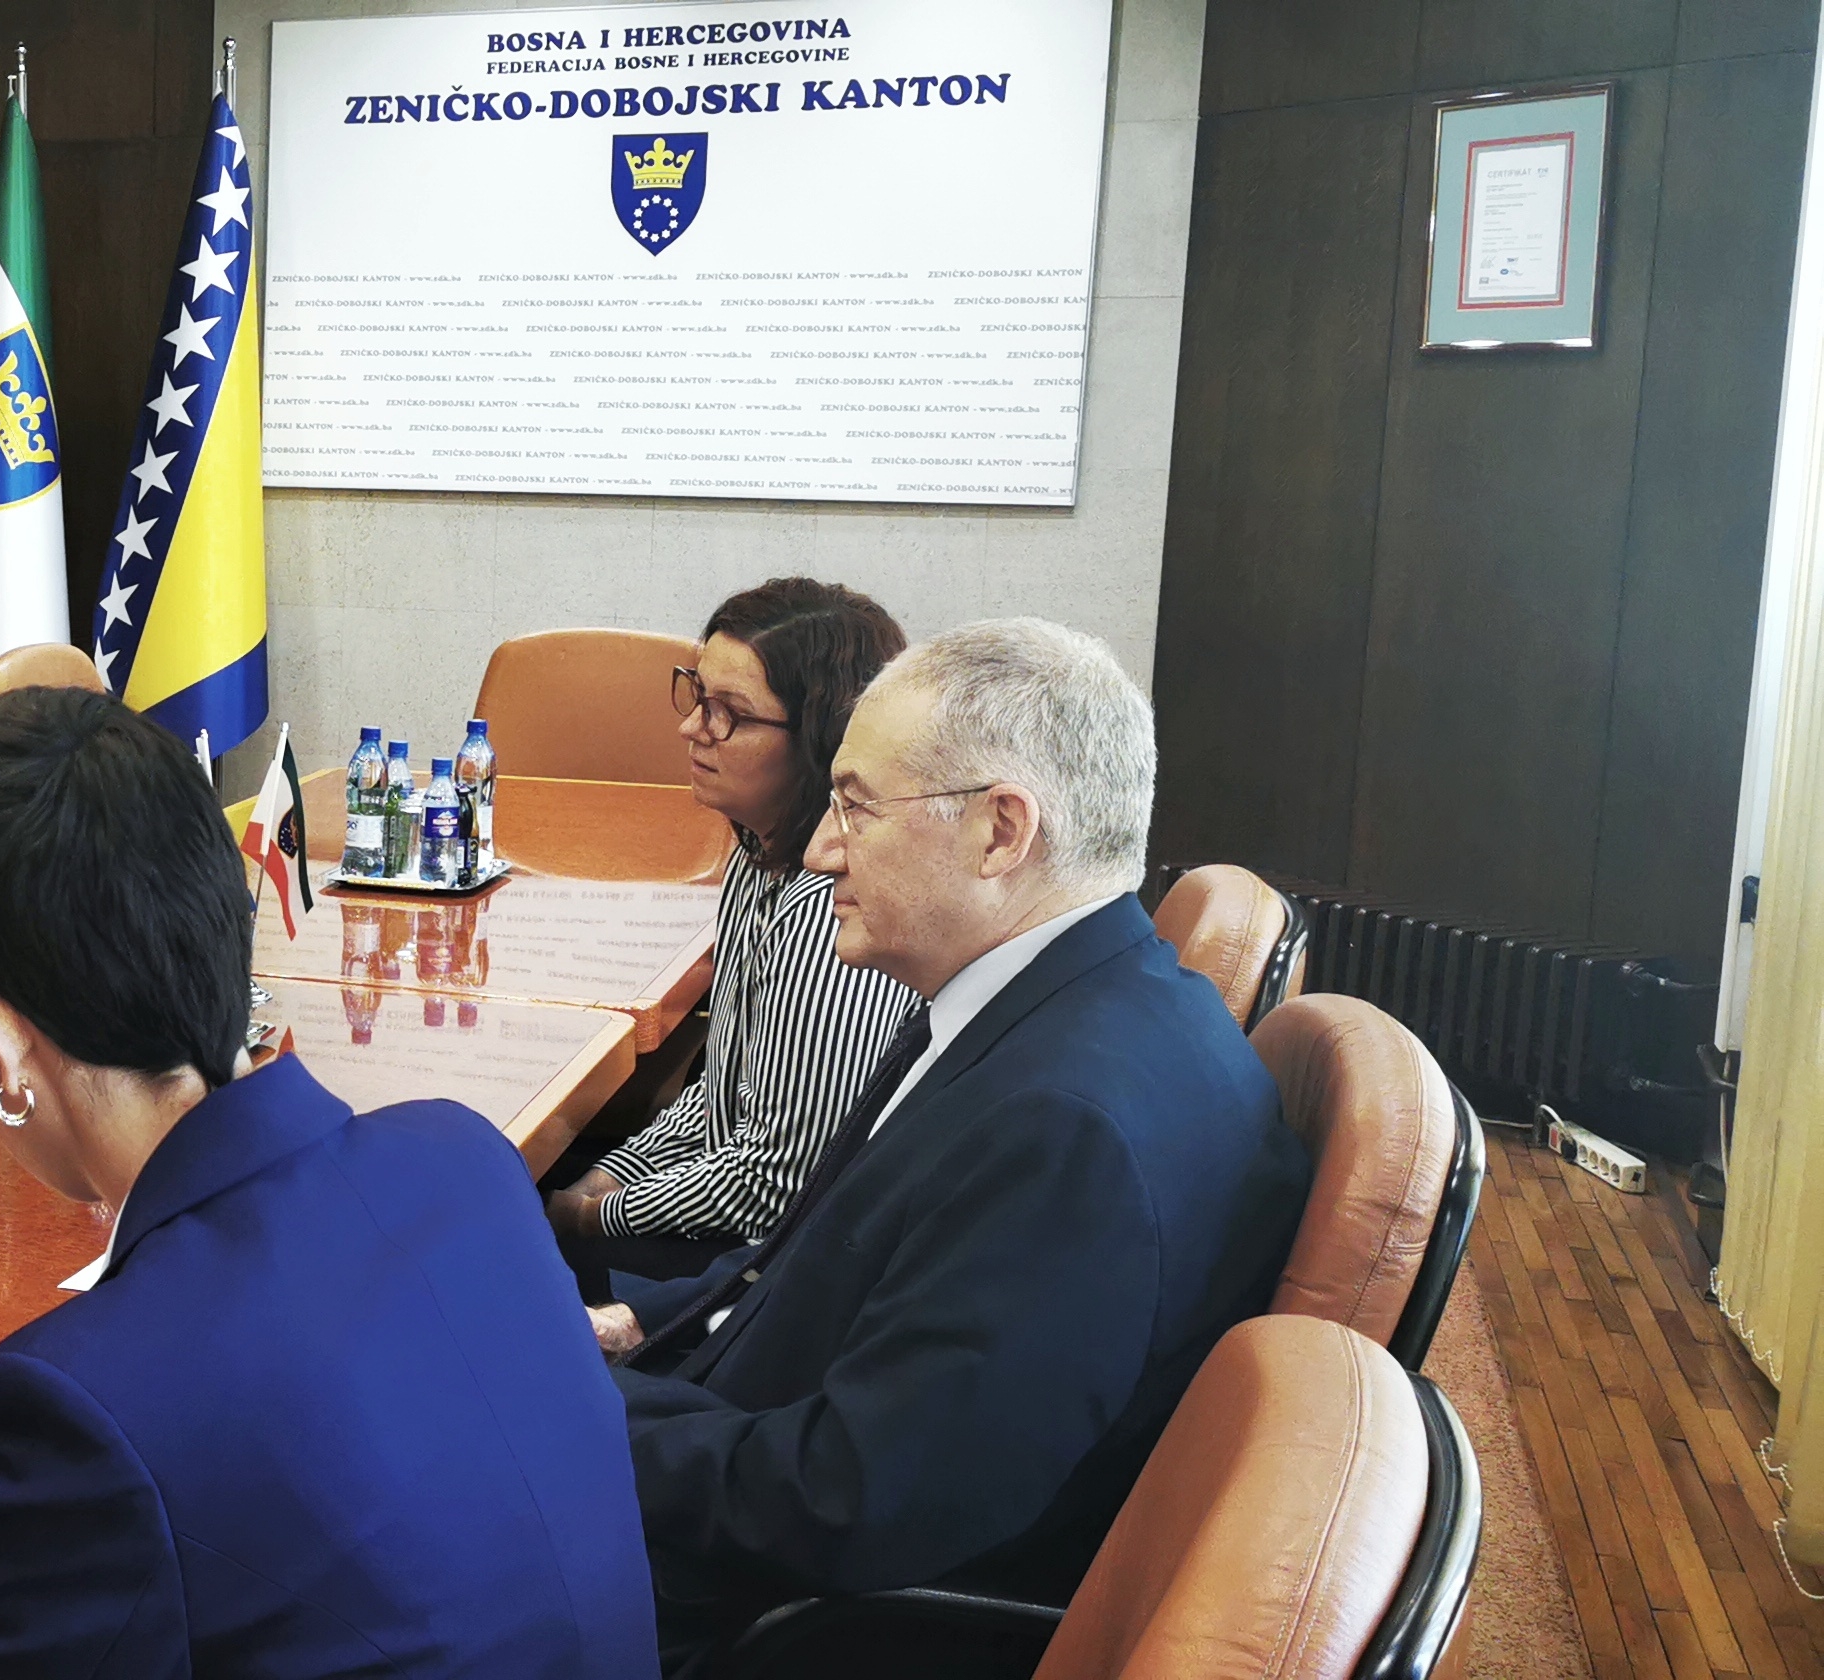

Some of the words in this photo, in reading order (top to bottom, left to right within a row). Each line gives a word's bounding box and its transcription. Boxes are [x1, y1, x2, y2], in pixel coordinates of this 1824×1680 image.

[486, 29, 587, 53] BOSNA
[599, 29, 611, 49] I
[623, 18, 852, 48] HERCEGOVINA
[486, 57, 606, 75] FEDERACIJA
[614, 54, 680, 70] BOSNE
[687, 53, 695, 68] I
[702, 47, 850, 67] HERCEGOVINE
[343, 82, 781, 125] ZENIČKO-DOBOJSKI
[800, 72, 1012, 111] KANTON
[362, 274, 401, 283] KANTON
[573, 273, 615, 282] KANTON
[796, 271, 840, 280] KANTON
[1036, 268, 1084, 277] KANTON
[385, 299, 425, 307] KANTON
[597, 299, 639, 307] KANTON
[822, 298, 866, 306] KANTON
[408, 324, 448, 332] KANTON
[621, 324, 663, 333] KANTON
[847, 324, 892, 333] KANTON
[431, 349, 472, 358] KANTON
[646, 350, 688, 359] KANTON
[873, 351, 918, 360] KANTON
[454, 374, 495, 383] KANTON
[670, 376, 712, 385] KANTON
[898, 378, 944, 386] KANTON
[273, 397, 311, 406] KANTON
[478, 400, 518, 408] KANTON
[694, 402, 737, 410] KANTON
[924, 404, 970, 413] KANTON
[295, 422, 334, 430] KANTON
[501, 425, 542, 433] KANTON
[718, 428, 762, 437] KANTON
[950, 431, 997, 440] KANTON
[318, 447, 356, 455] KANTON
[525, 450, 566, 459] KANTON
[743, 454, 787, 463] KANTON
[976, 458, 1023, 467] KANTON
[340, 471, 379, 479] KANTON
[549, 476, 589, 484] KANTON
[768, 480, 811, 489] KANTON
[1003, 485, 1050, 495] KANTON
